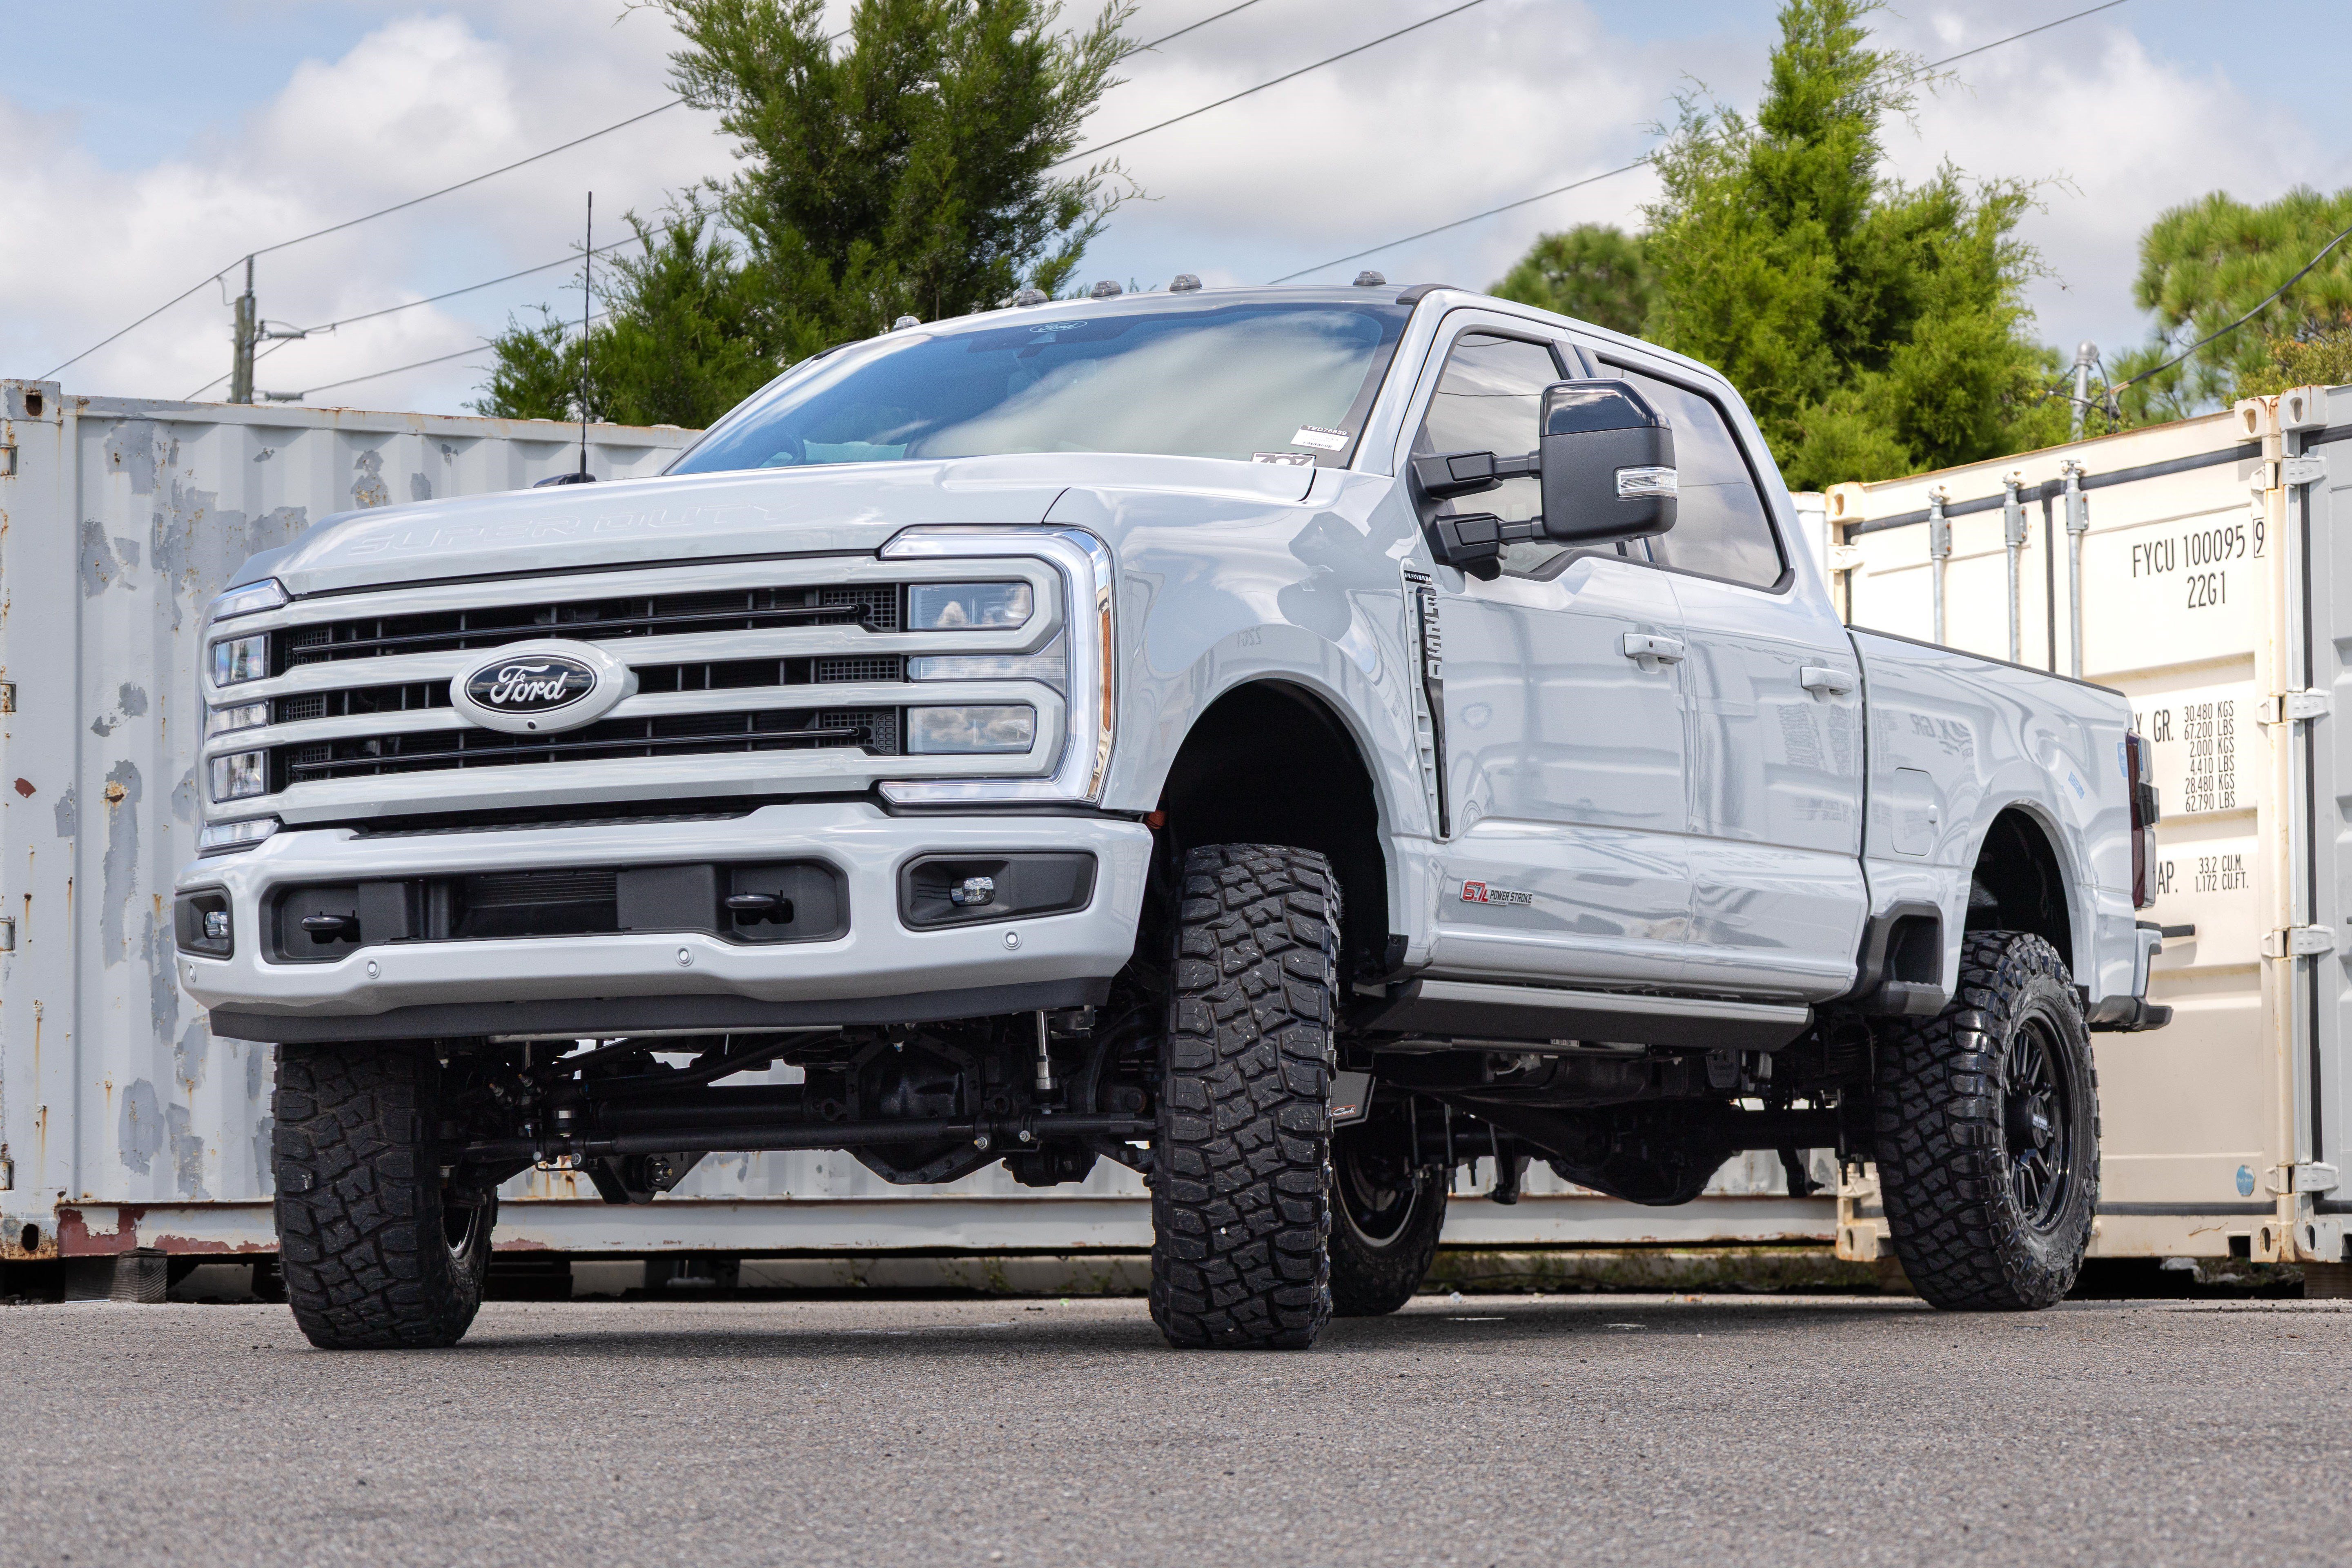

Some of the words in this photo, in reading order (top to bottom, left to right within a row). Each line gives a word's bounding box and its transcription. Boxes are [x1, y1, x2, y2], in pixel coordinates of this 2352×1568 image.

[1038, 322, 1078, 331] Ford
[1307, 425, 1347, 436] TED76859
[348, 516, 581, 556] SUPER
[594, 503, 801, 532] DUTY
[2132, 538, 2175, 578] FYCU
[2183, 524, 2246, 568] 100095
[2255, 521, 2265, 554] 9
[2187, 570, 2226, 609] 22G1
[490, 665, 569, 704] Ford
[2154, 709, 2174, 742] GR.
[2184, 703, 2214, 723] 30.480
[2217, 700, 2234, 718] KGS
[2184, 720, 2214, 740] 67.200
[2218, 719, 2234, 737] LBS
[2189, 738, 2214, 757] 2.000
[2218, 737, 2235, 754] KGS
[2189, 757, 2214, 775] 4.410
[2218, 755, 2235, 773] LBS
[2185, 775, 2214, 795] 28.480
[2218, 773, 2235, 791] KGS
[2185, 793, 2214, 813] 62.790
[2218, 791, 2236, 809] LBS
[2157, 860, 2178, 894] AP.
[2198, 857, 2217, 874] 33.2
[2222, 854, 2243, 871] CU.M.
[2195, 874, 2217, 893] 1.172
[2222, 871, 2249, 890] CU.FT.
[1489, 889, 1510, 901] POWER
[1510, 892, 1532, 903] STROKE
[1332, 1107, 1355, 1116] Carli
